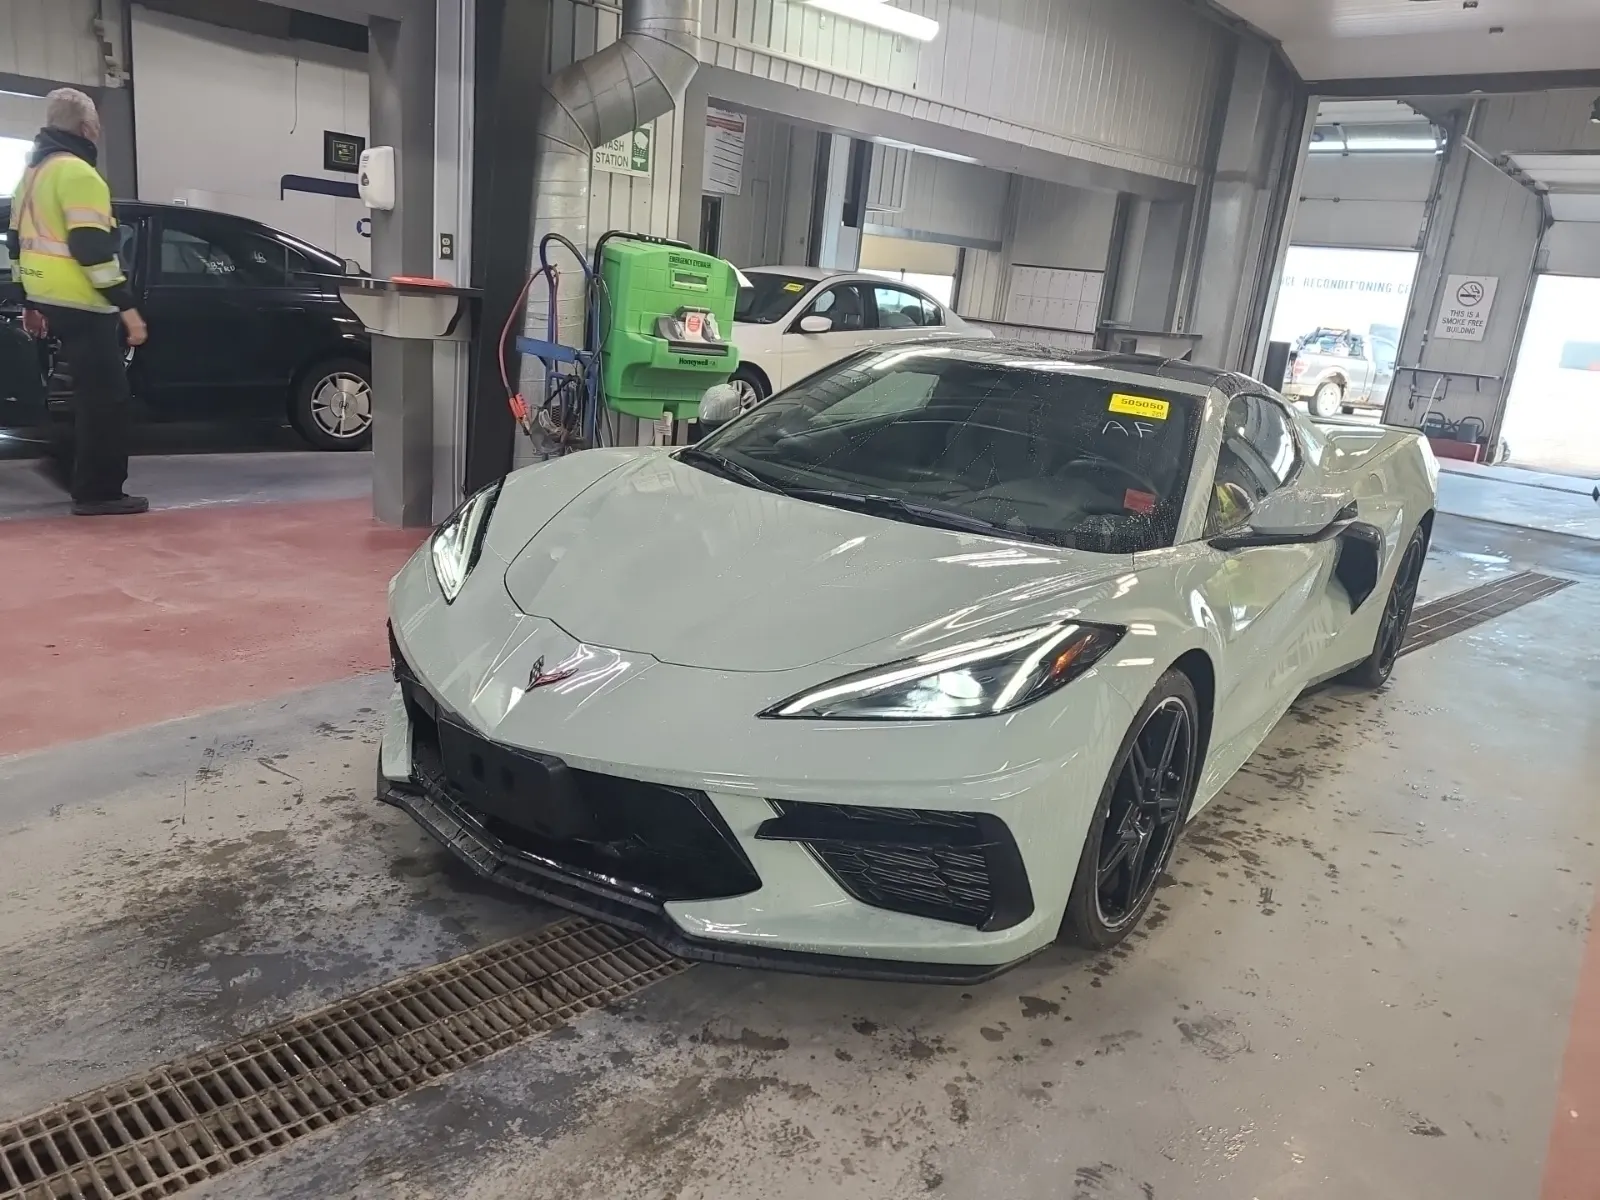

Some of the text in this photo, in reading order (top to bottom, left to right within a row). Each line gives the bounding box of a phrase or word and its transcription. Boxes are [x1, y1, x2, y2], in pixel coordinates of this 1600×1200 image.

[595, 151, 629, 168] STATION
[1450, 309, 1465, 318] THIS
[1467, 310, 1474, 318] IS
[1441, 317, 1484, 327] SMOKE FREE
[1446, 326, 1476, 335] BUILDING
[678, 357, 708, 367] Honeywell
[1121, 398, 1164, 411] 505050
